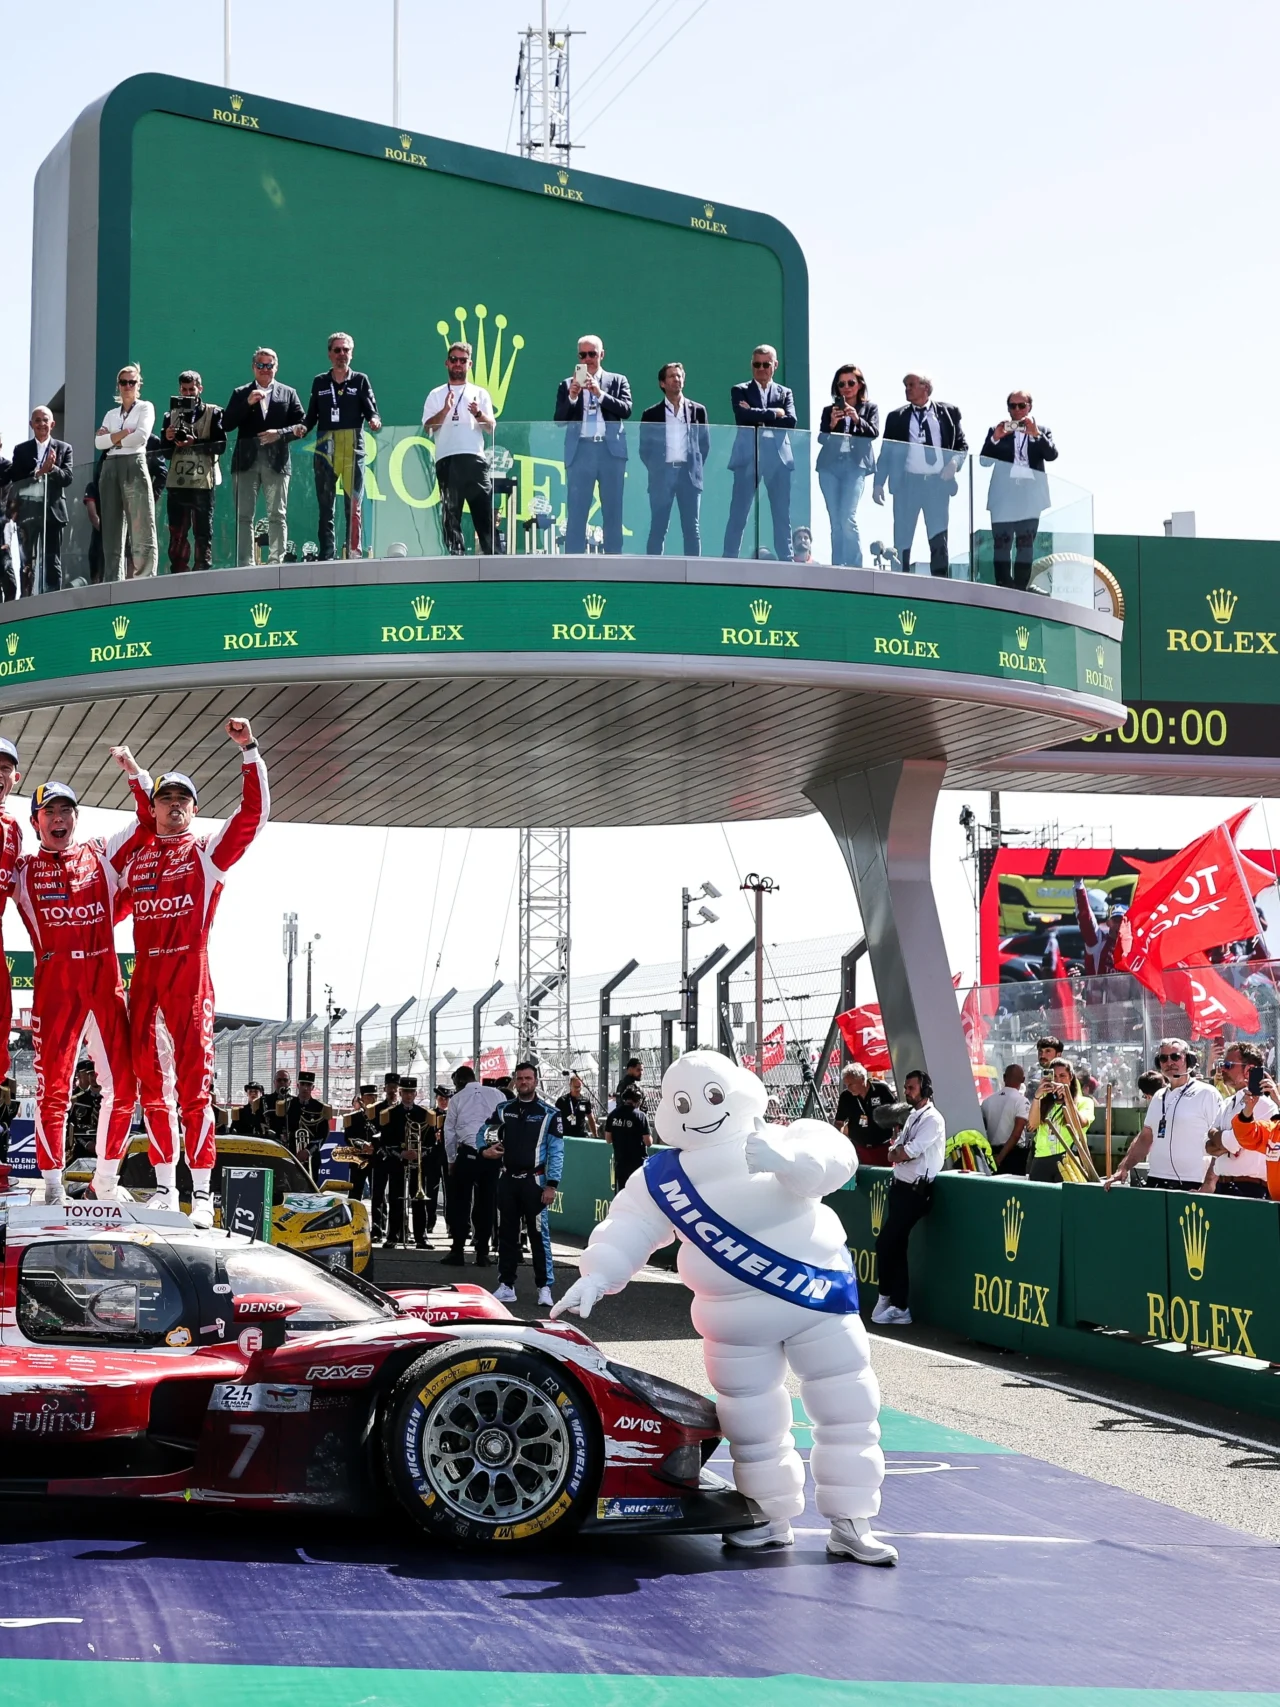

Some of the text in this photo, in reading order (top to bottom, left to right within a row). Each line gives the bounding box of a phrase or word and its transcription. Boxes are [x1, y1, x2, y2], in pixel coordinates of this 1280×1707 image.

[212, 107, 260, 129] ROLEX
[385, 147, 428, 167] ROLEX
[544, 182, 584, 202] ROLEX
[690, 215, 728, 234] ROLEX
[223, 630, 298, 651] ROLEX
[381, 624, 464, 642] ROLEX
[551, 623, 637, 641] ROLEX
[721, 627, 800, 648] ROLEX
[1166, 629, 1279, 655] ROLEX
[90, 641, 152, 663] ROLEX
[874, 637, 940, 660] ROLEX
[998, 651, 1048, 674] ROLEX
[1085, 669, 1114, 693] ROLEX
[34, 881, 57, 890] Mobil
[132, 872, 150, 881] Mobil
[40, 901, 105, 921] TOYOTA
[134, 894, 195, 914] TOYOTA
[44, 915, 106, 927] RACING
[133, 908, 195, 921] RACING
[63, 1205, 123, 1218] TOYOTA
[659, 1179, 832, 1300] MICHELIN
[239, 1302, 286, 1314] DENSO
[973, 1273, 1050, 1328] ROLEX
[410, 1312, 459, 1321] OYOTA 7
[1146, 1292, 1257, 1358] ROLEX
[246, 1336, 259, 1351] E
[305, 1364, 374, 1381] RAYS
[439, 1368, 461, 1384] SPORT
[222, 1385, 253, 1401] 24h
[11, 1408, 97, 1436] FUJITSU
[228, 1424, 265, 1479] 7
[405, 1407, 423, 1481] MICHELIN
[570, 1418, 587, 1493] MICHELIN
